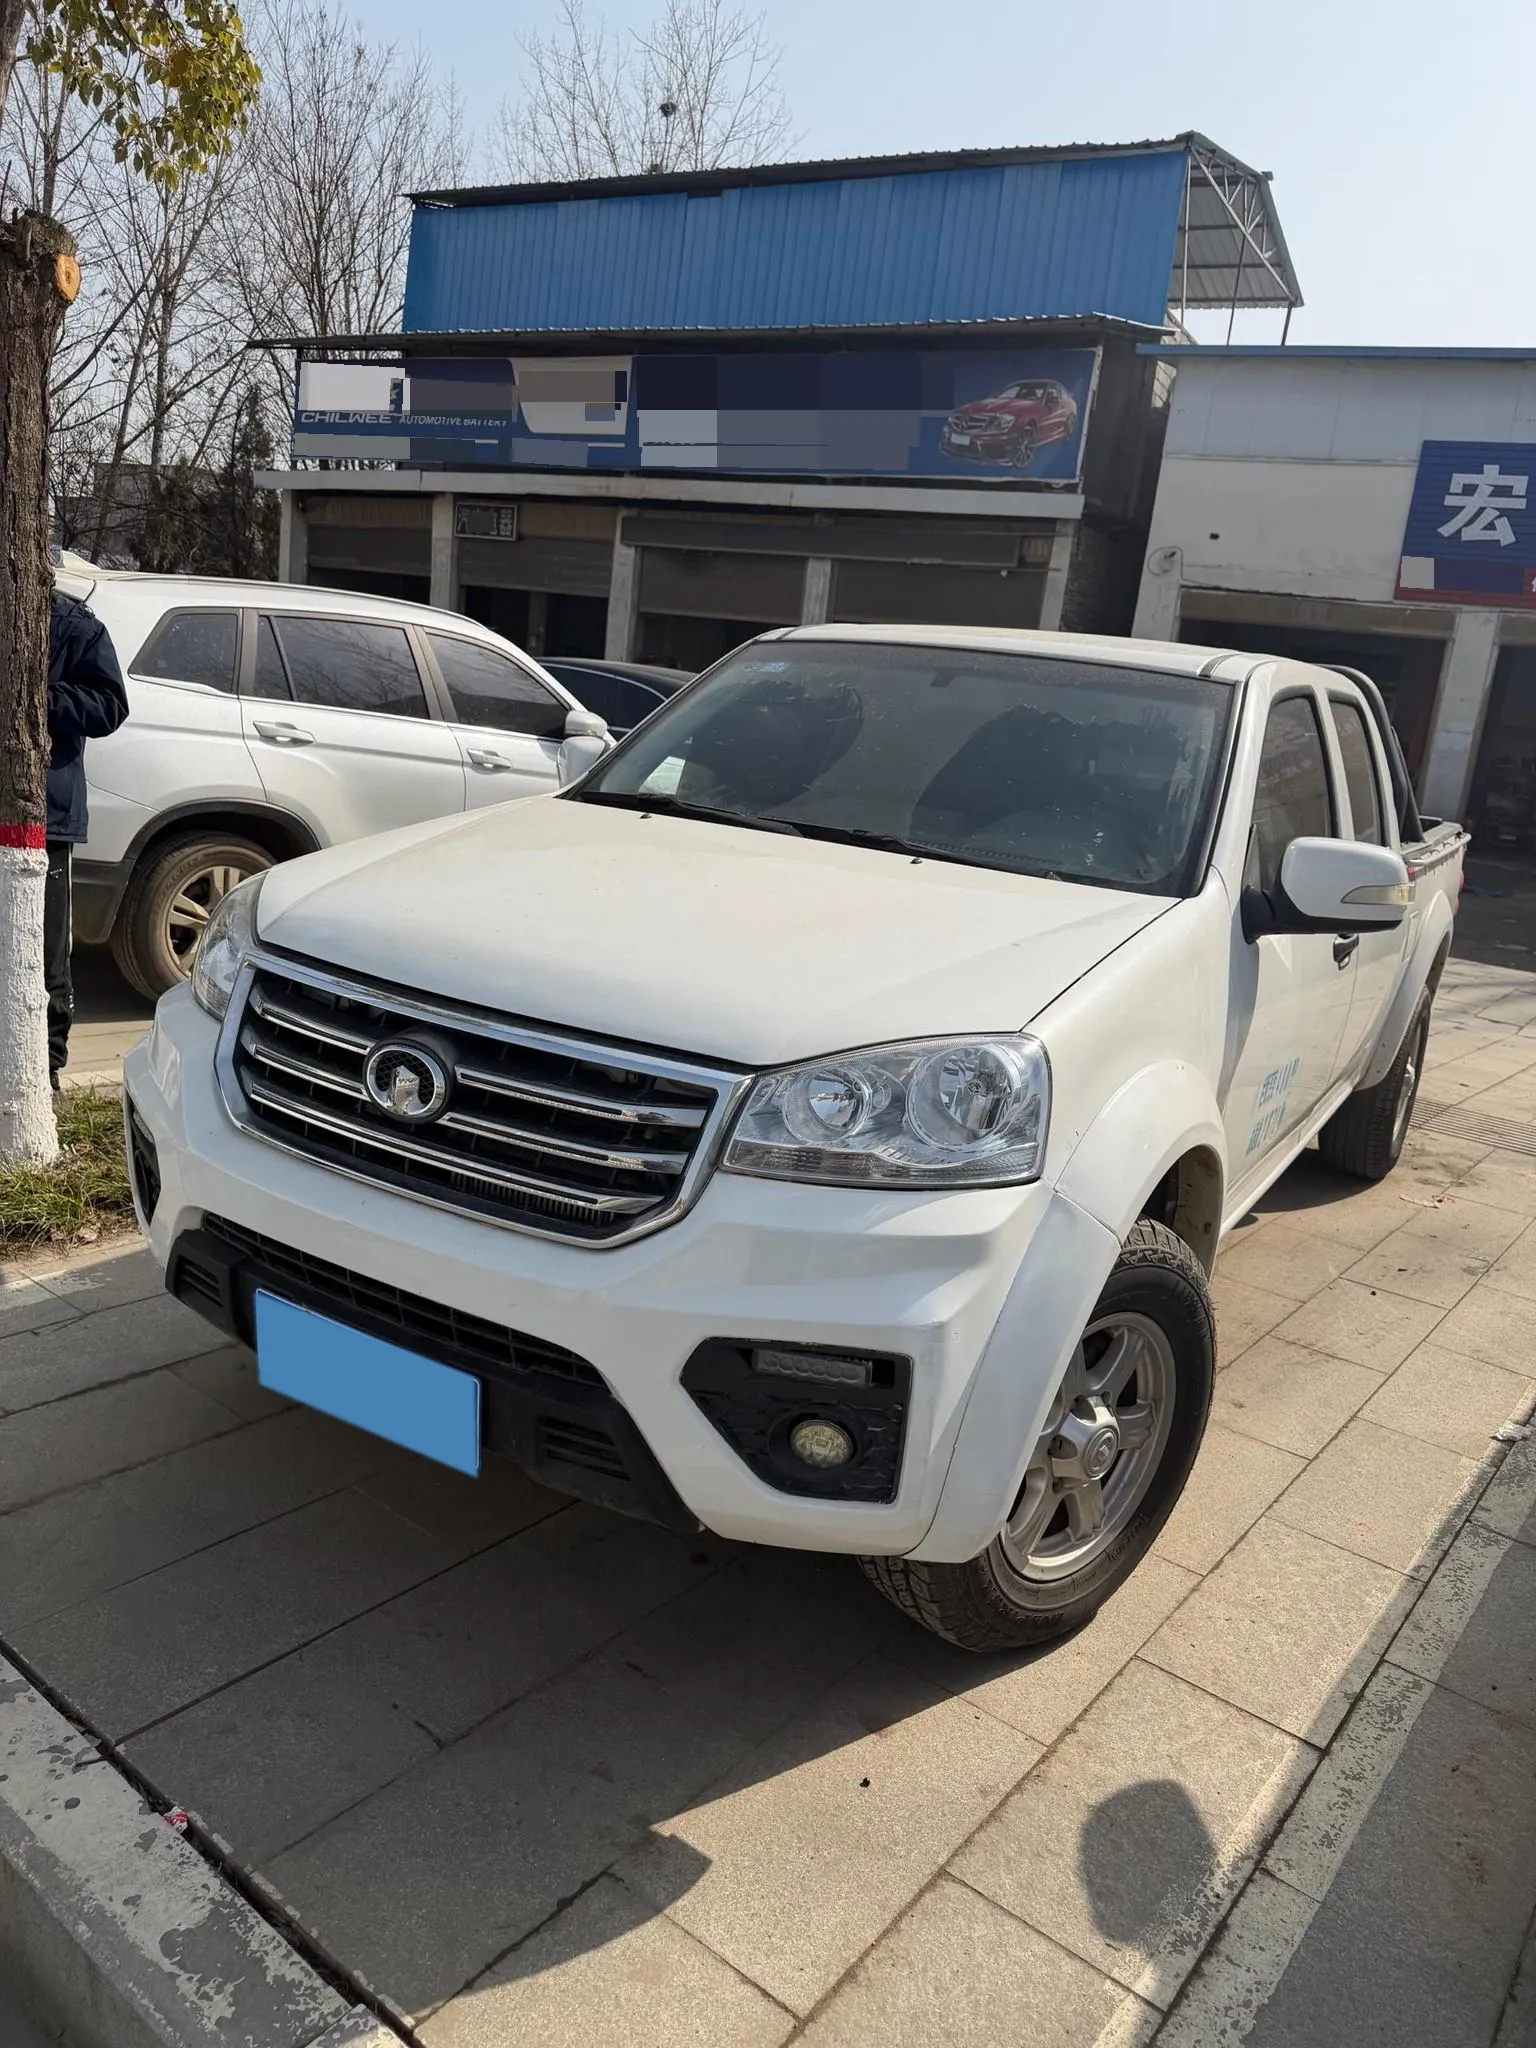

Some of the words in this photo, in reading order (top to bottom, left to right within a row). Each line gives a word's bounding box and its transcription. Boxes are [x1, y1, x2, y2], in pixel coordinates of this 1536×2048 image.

[301, 411, 392, 424] CHILWEE
[399, 415, 461, 425] AUTOMOTIVE
[1437, 464, 1529, 546] 宏
